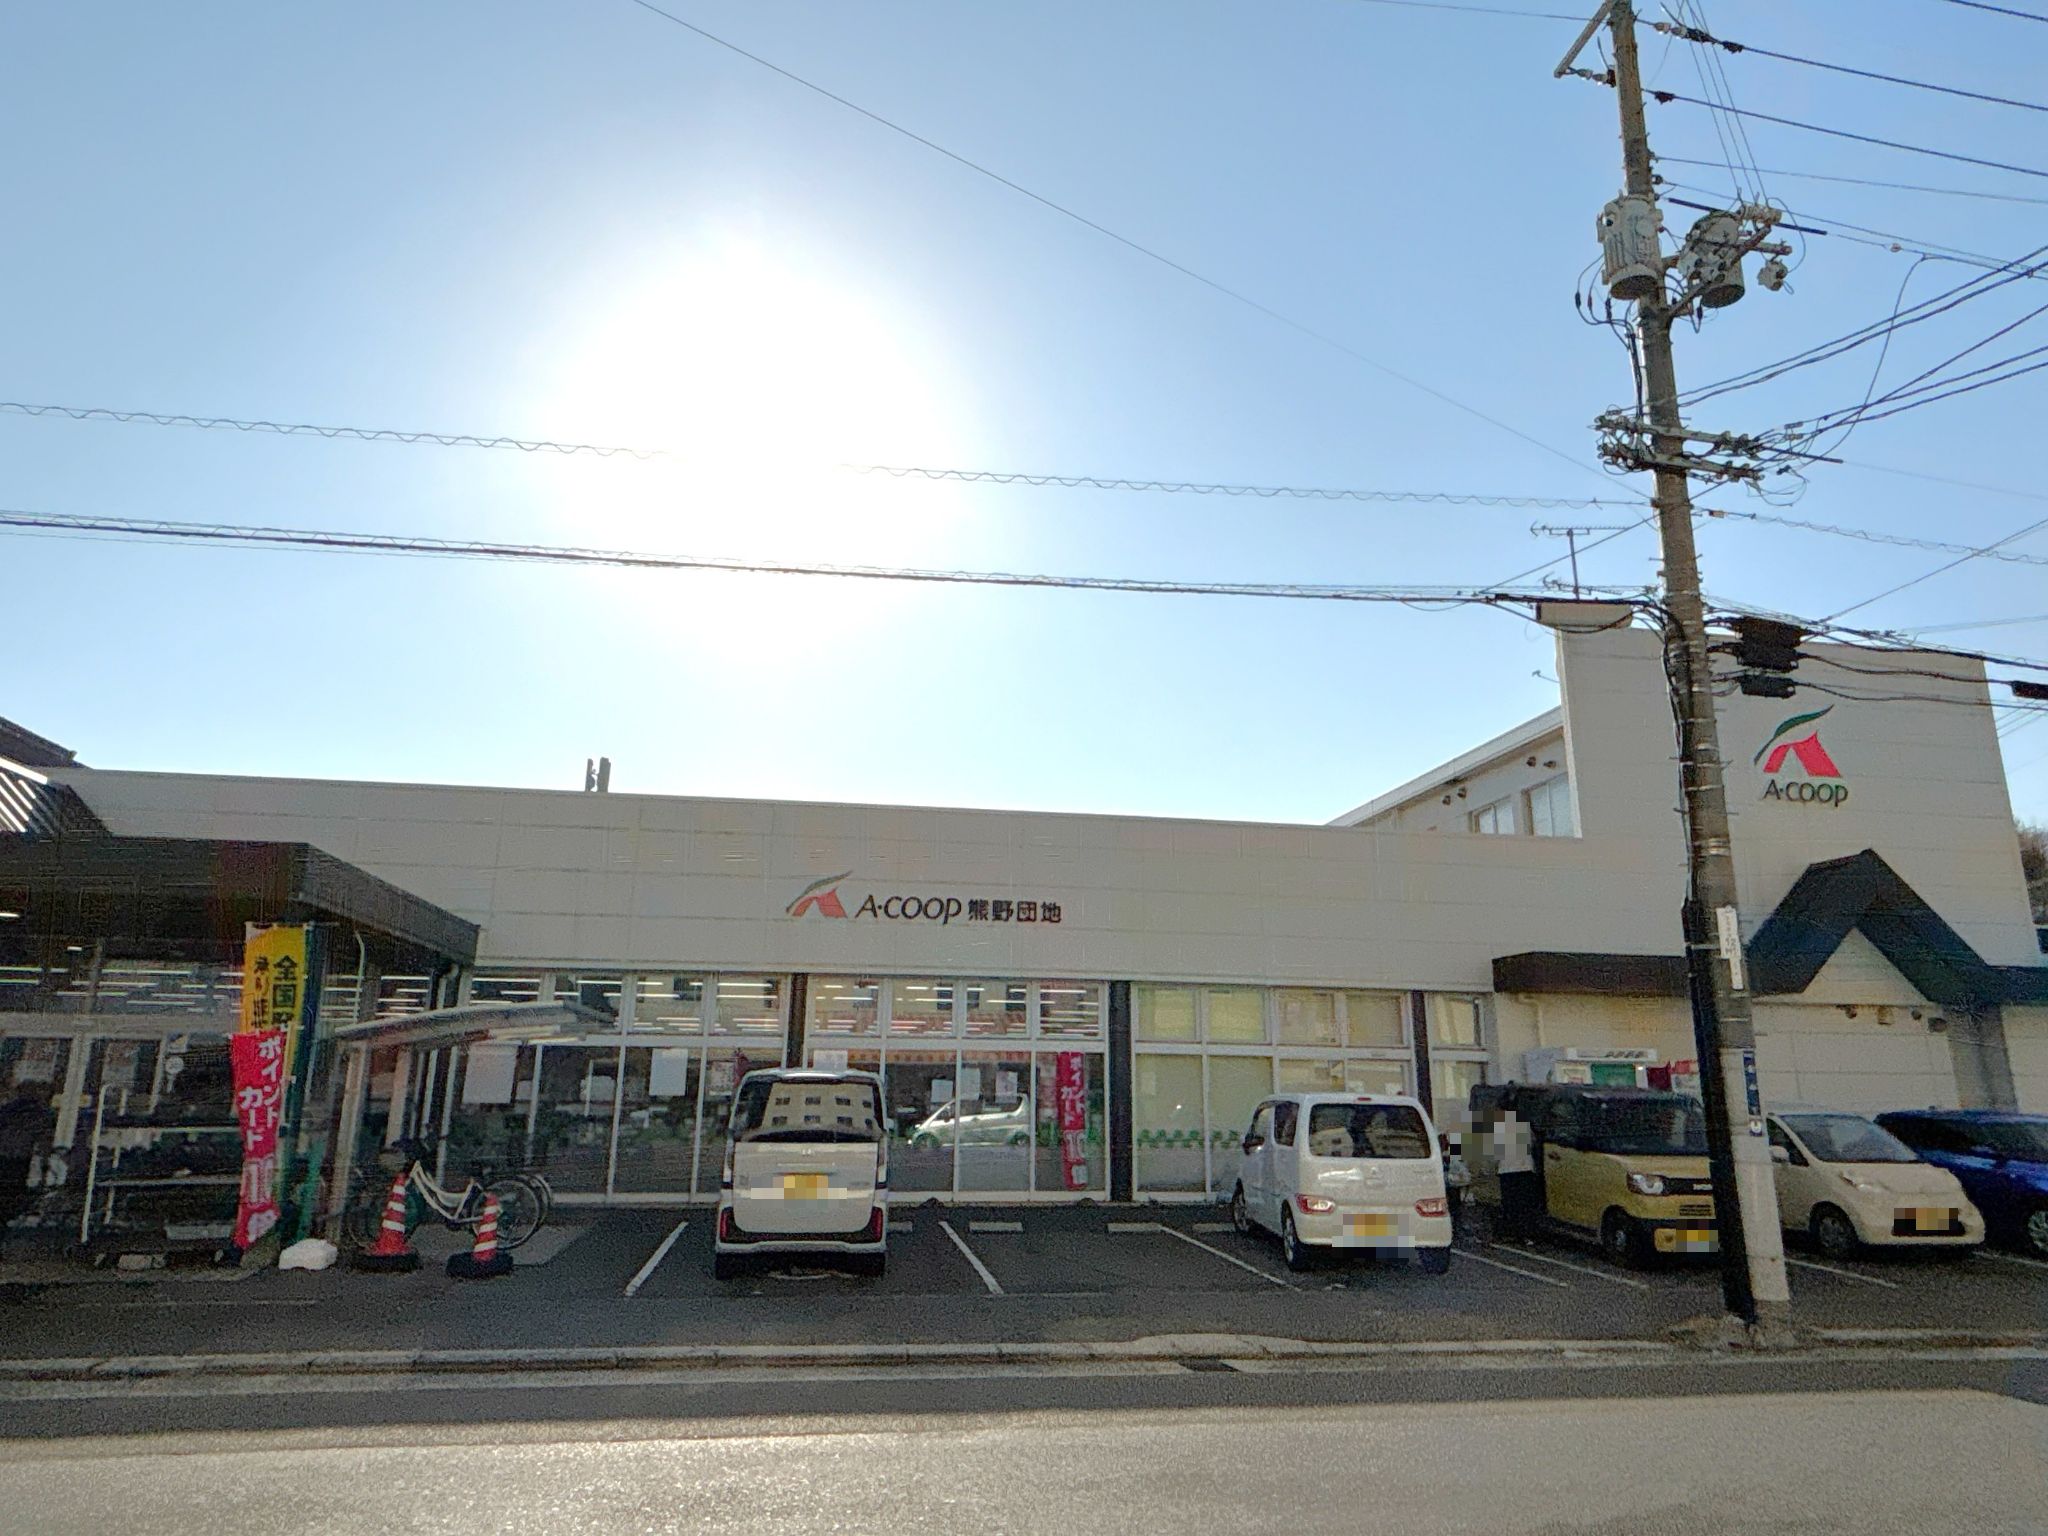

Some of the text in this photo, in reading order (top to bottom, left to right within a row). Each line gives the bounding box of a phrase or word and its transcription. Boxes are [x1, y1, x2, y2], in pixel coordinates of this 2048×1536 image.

[967, 898, 1062, 924] 熊野団地
[258, 1036, 281, 1128] ポイント
[1070, 1056, 1086, 1114] ポイント
[239, 1086, 264, 1151] カード
